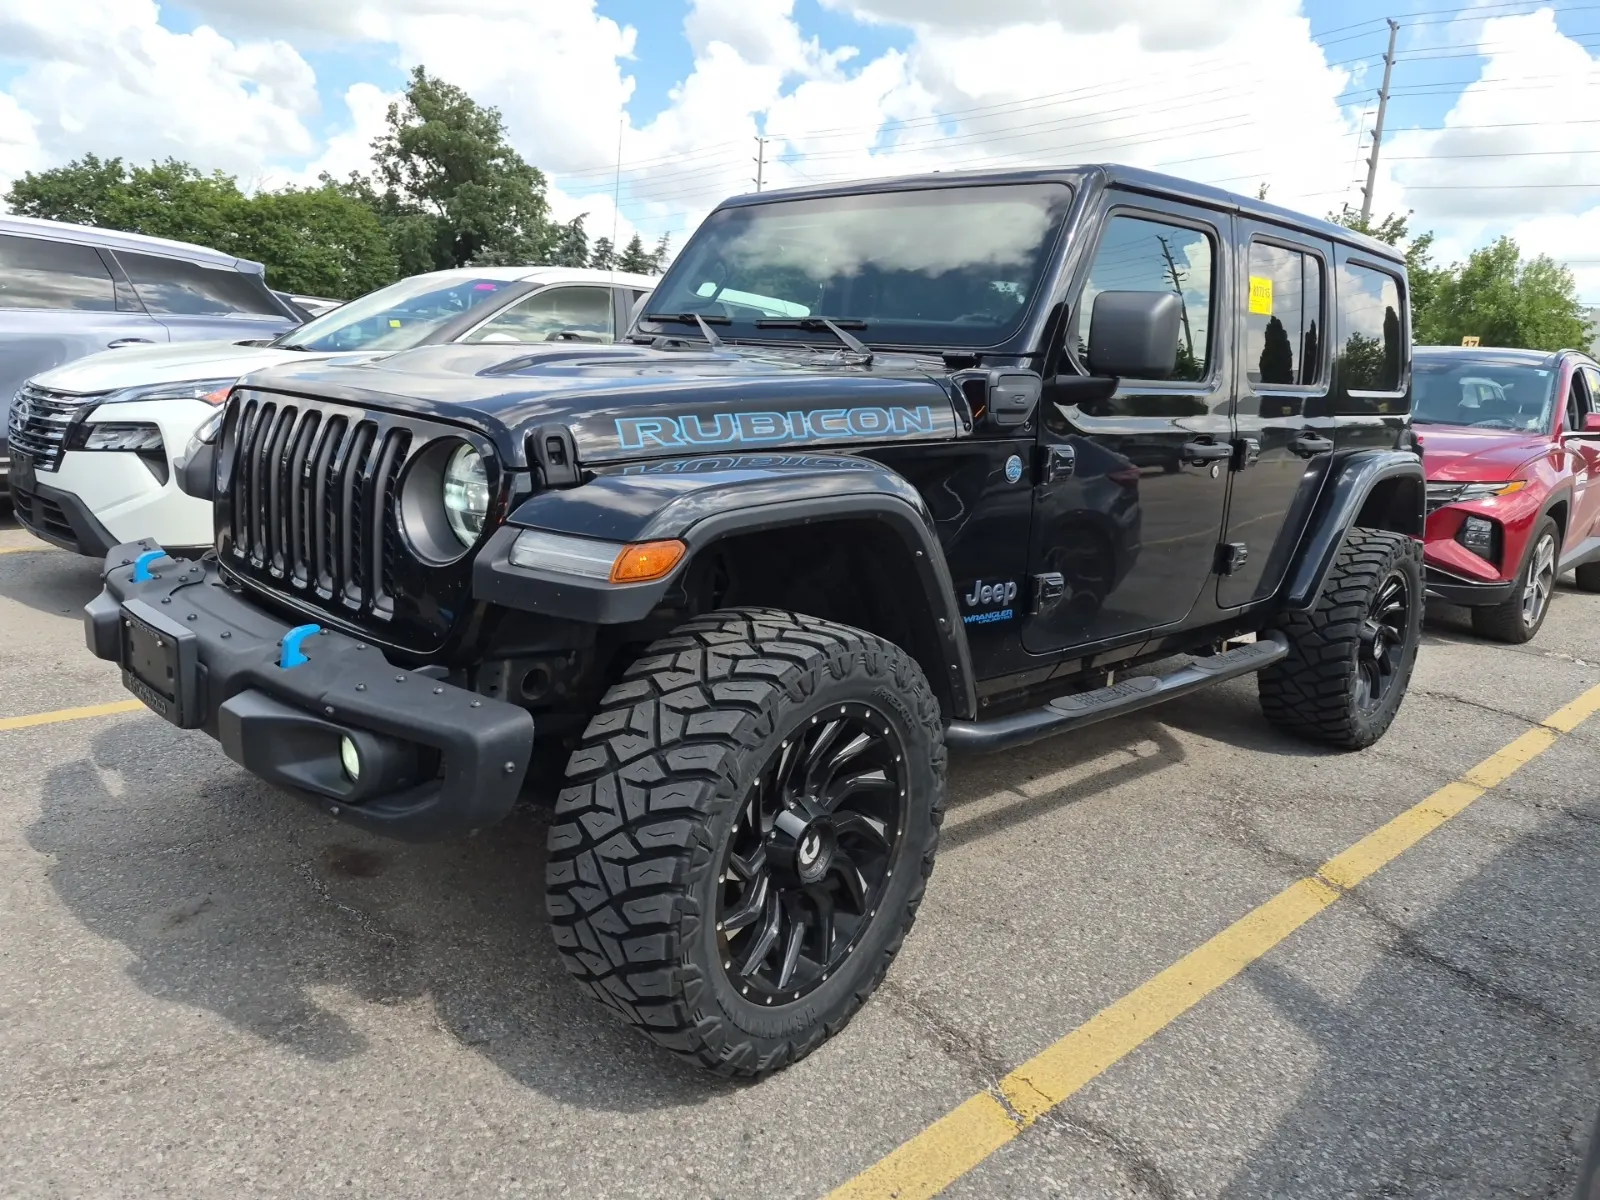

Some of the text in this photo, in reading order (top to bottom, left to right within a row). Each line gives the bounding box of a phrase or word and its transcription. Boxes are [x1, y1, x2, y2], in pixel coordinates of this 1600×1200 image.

[614, 406, 934, 449] RUBICON
[965, 579, 1018, 607] Jeep
[963, 609, 1013, 623] WRANGLER
